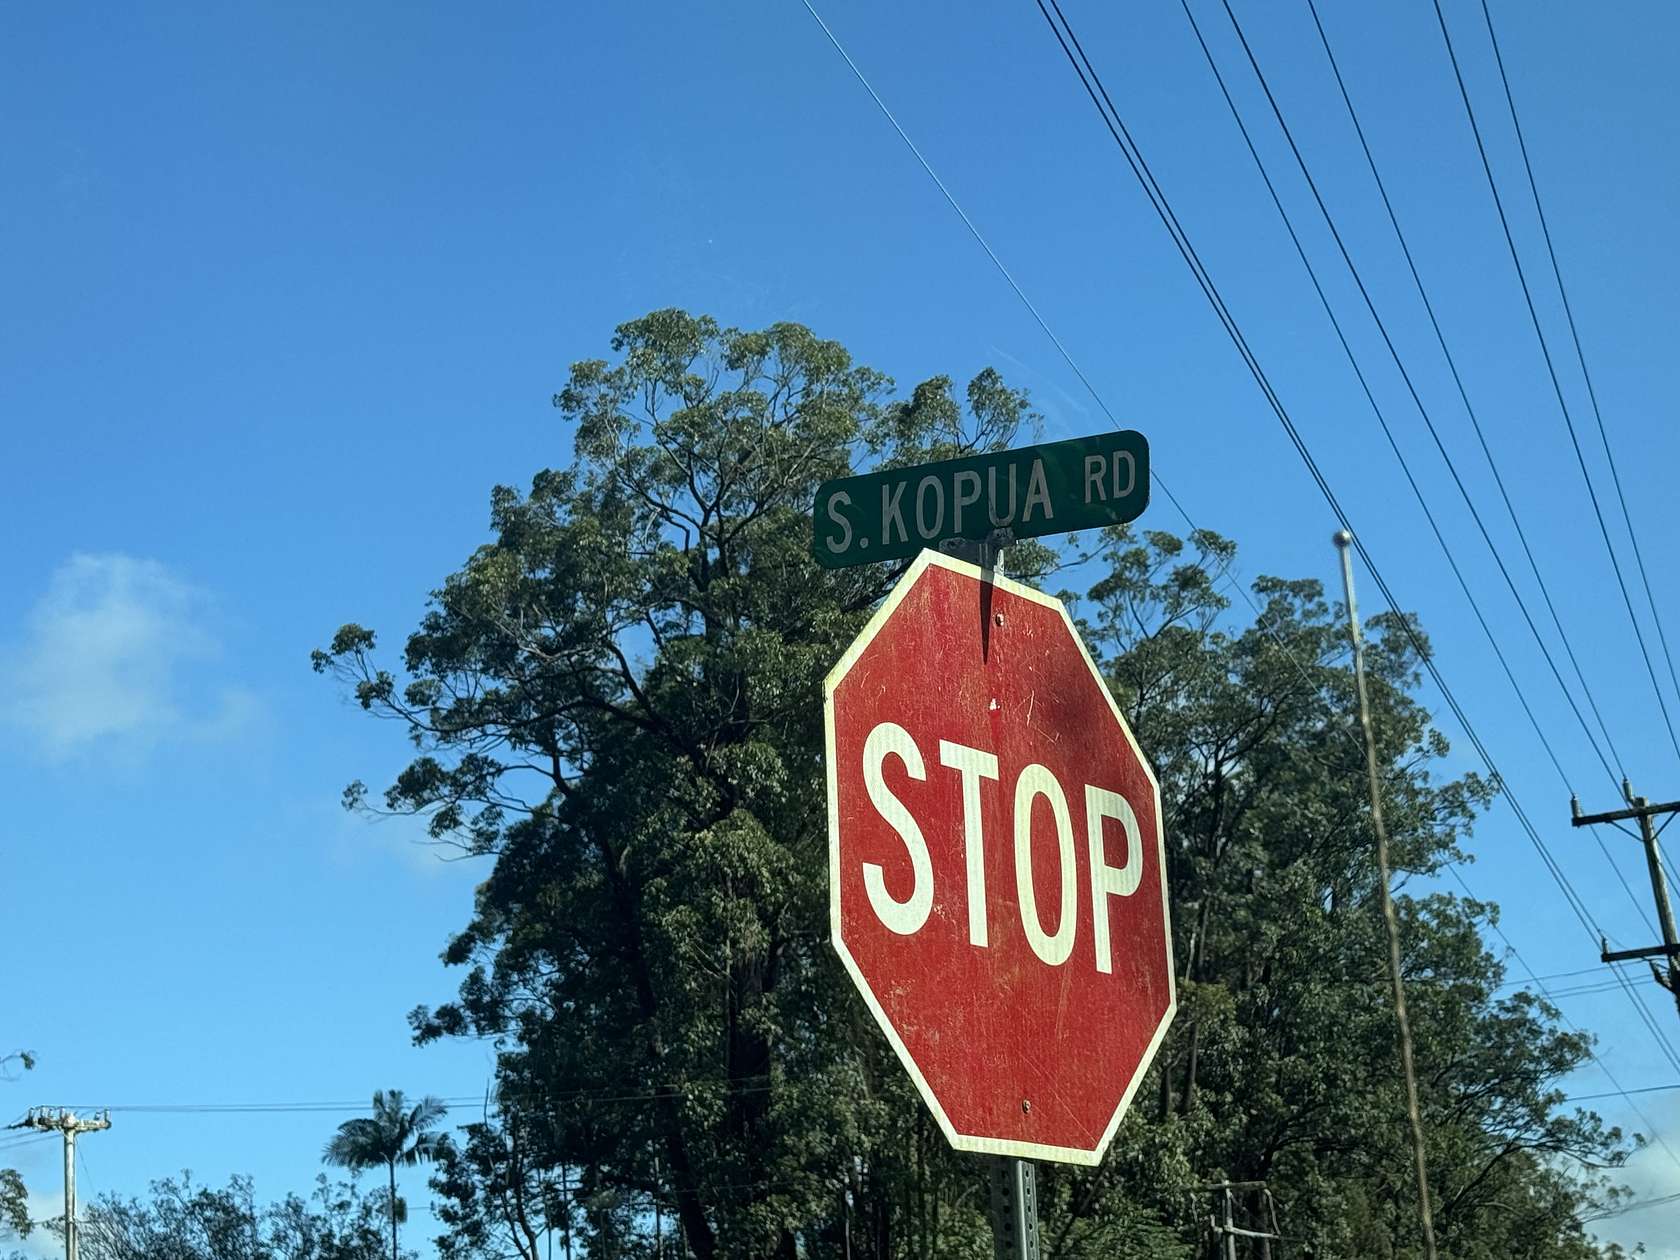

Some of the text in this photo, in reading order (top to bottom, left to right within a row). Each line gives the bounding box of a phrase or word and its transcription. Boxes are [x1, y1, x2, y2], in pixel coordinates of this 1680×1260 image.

[882, 459, 1054, 545] KOPUA
[1084, 450, 1136, 504] RD
[862, 722, 1143, 974] STOP
